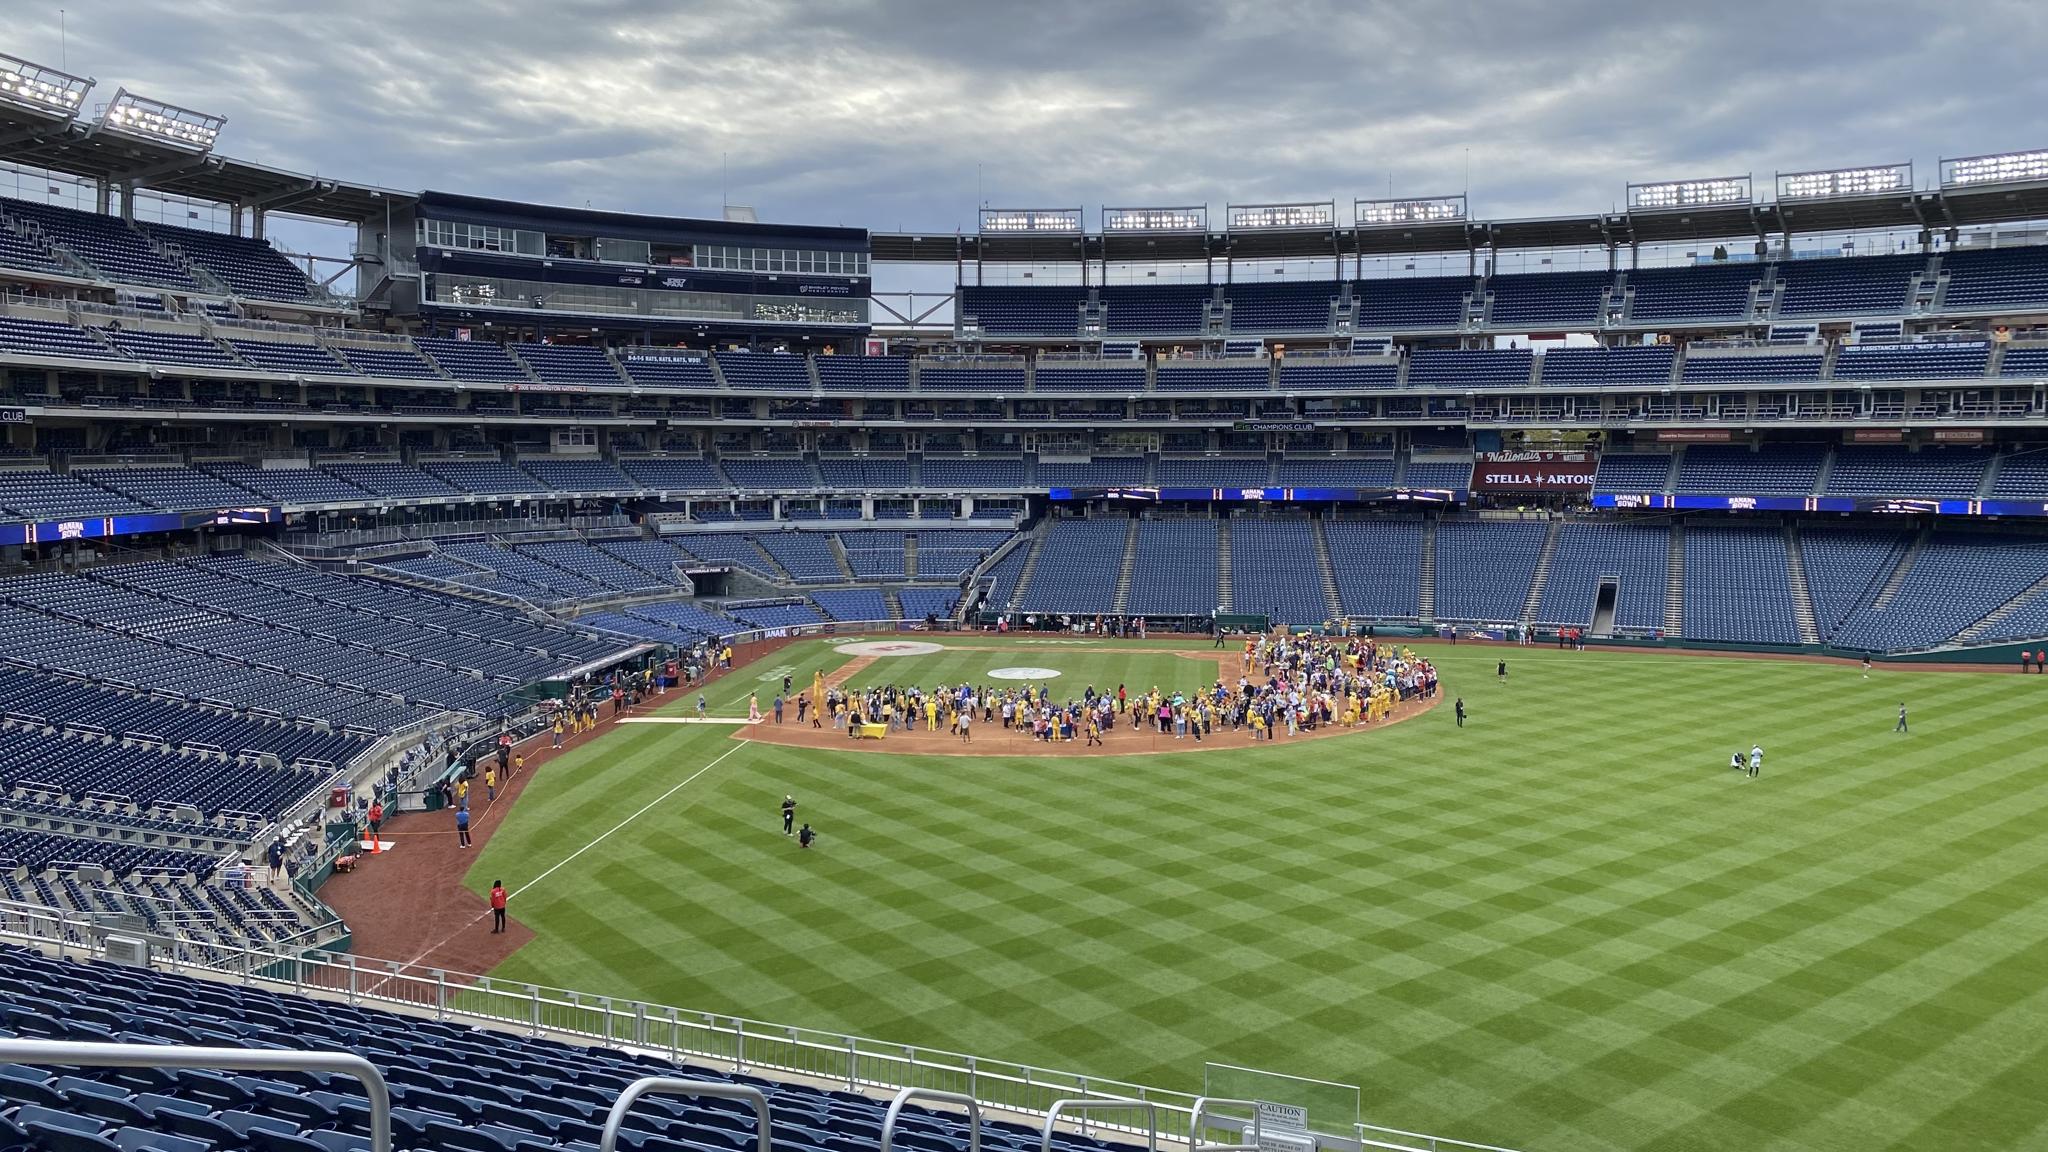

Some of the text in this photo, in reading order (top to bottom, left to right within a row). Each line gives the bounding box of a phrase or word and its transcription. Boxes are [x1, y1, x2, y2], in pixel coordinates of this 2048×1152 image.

[3, 411, 24, 420] CLUB
[1487, 452, 1541, 462] Nationals
[1486, 474, 1594, 484] STELLA ARTOIS
[1615, 495, 1642, 503] BANANA
[58, 522, 84, 532] BANANA
[62, 530, 82, 539] BOWL
[1260, 1104, 1300, 1116] CAUTION
